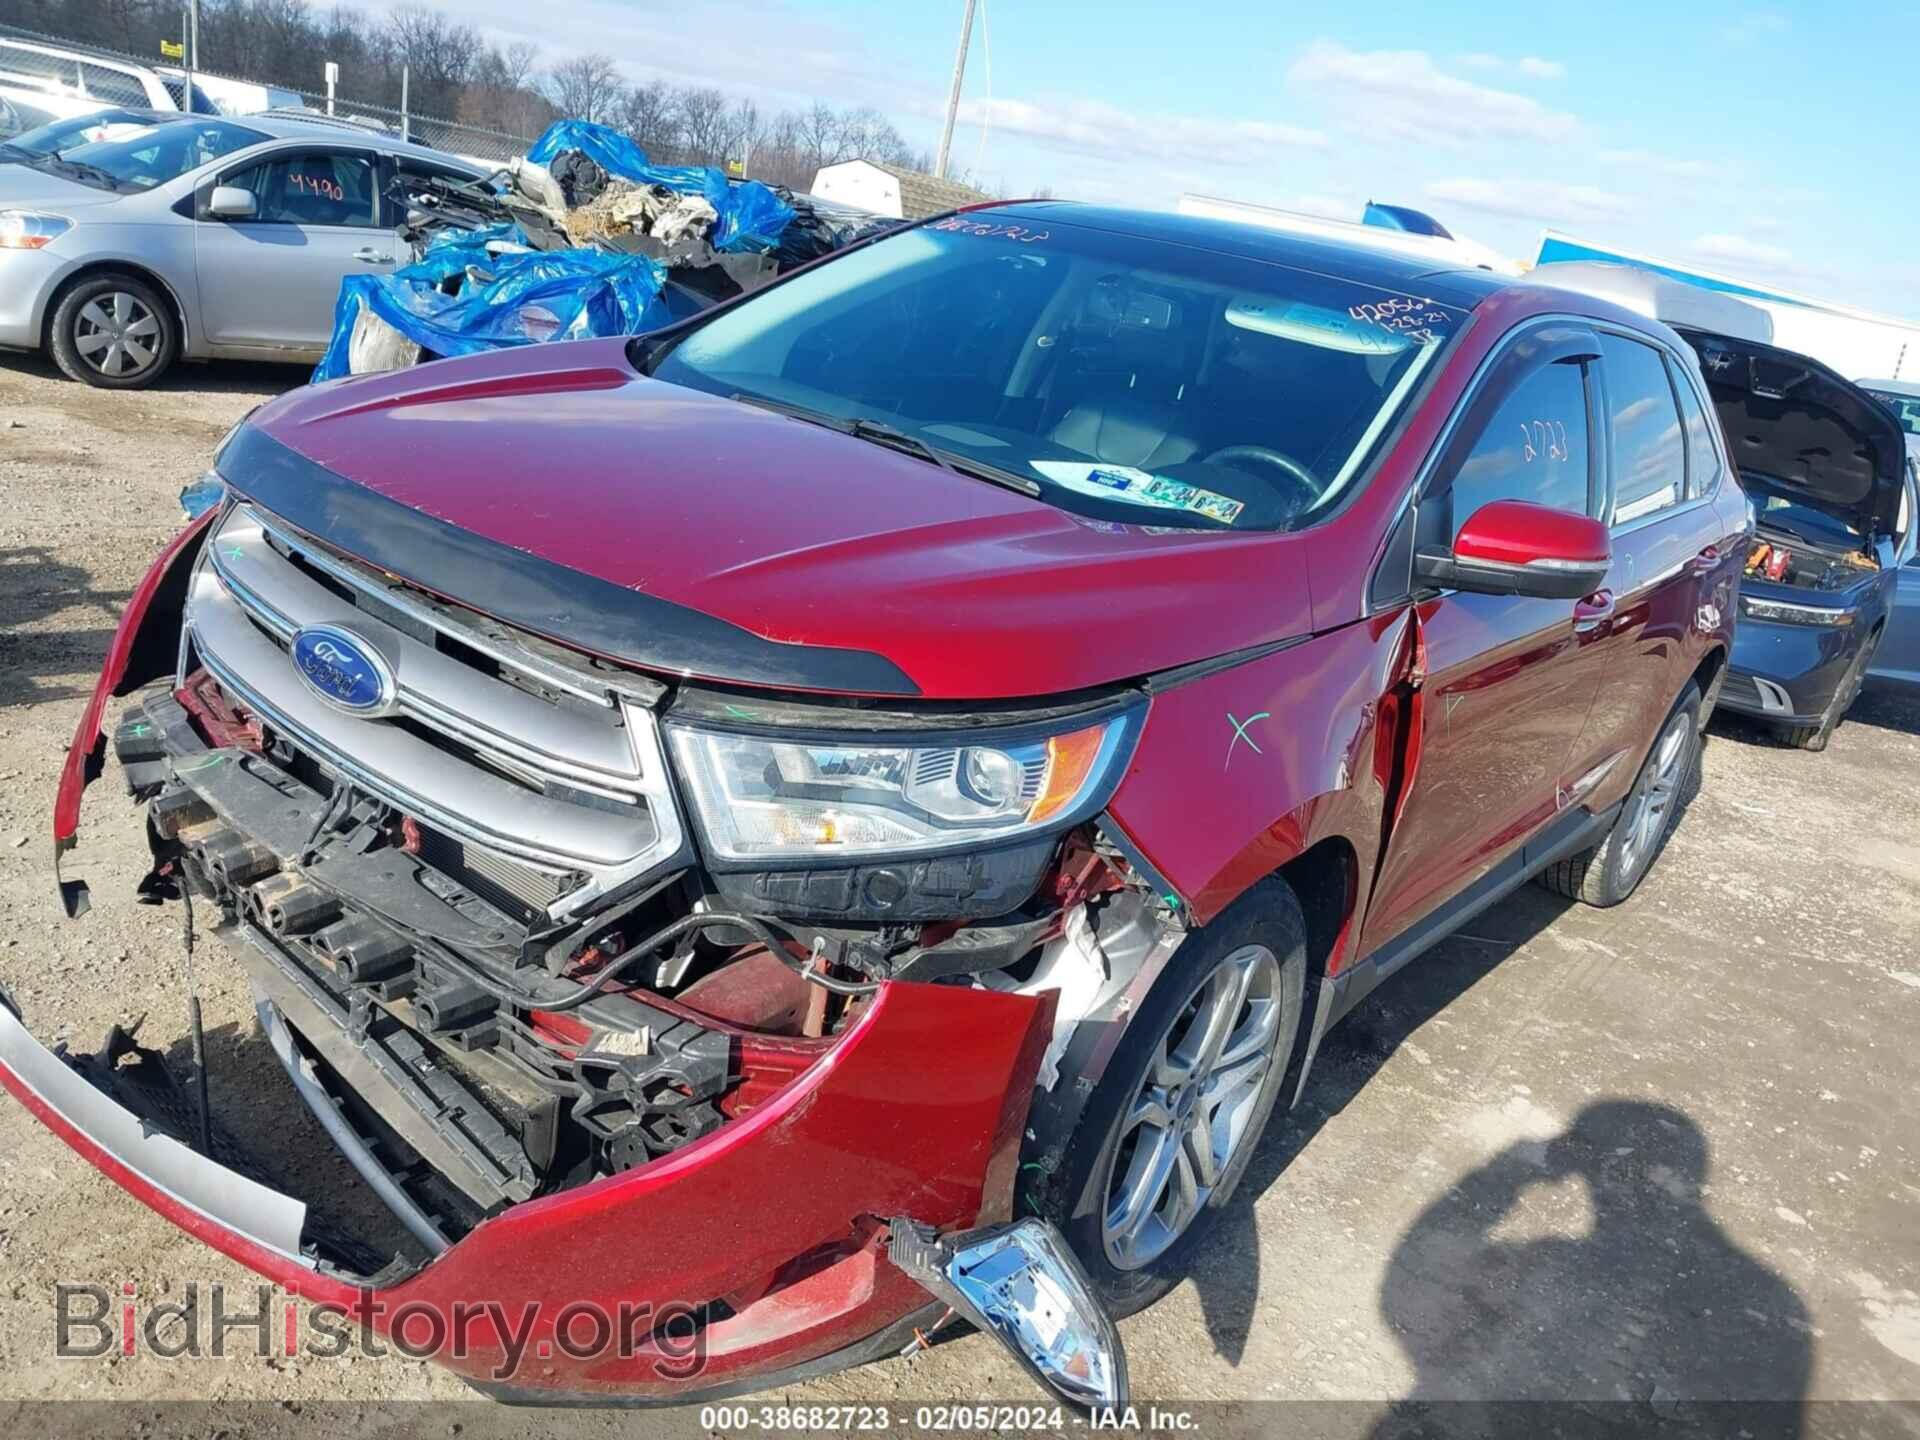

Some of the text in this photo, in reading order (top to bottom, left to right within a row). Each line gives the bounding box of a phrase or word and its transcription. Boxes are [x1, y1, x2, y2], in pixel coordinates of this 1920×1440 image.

[289, 173, 344, 200] 4490
[1520, 420, 1568, 462] 2723
[305, 641, 363, 698] Ford
